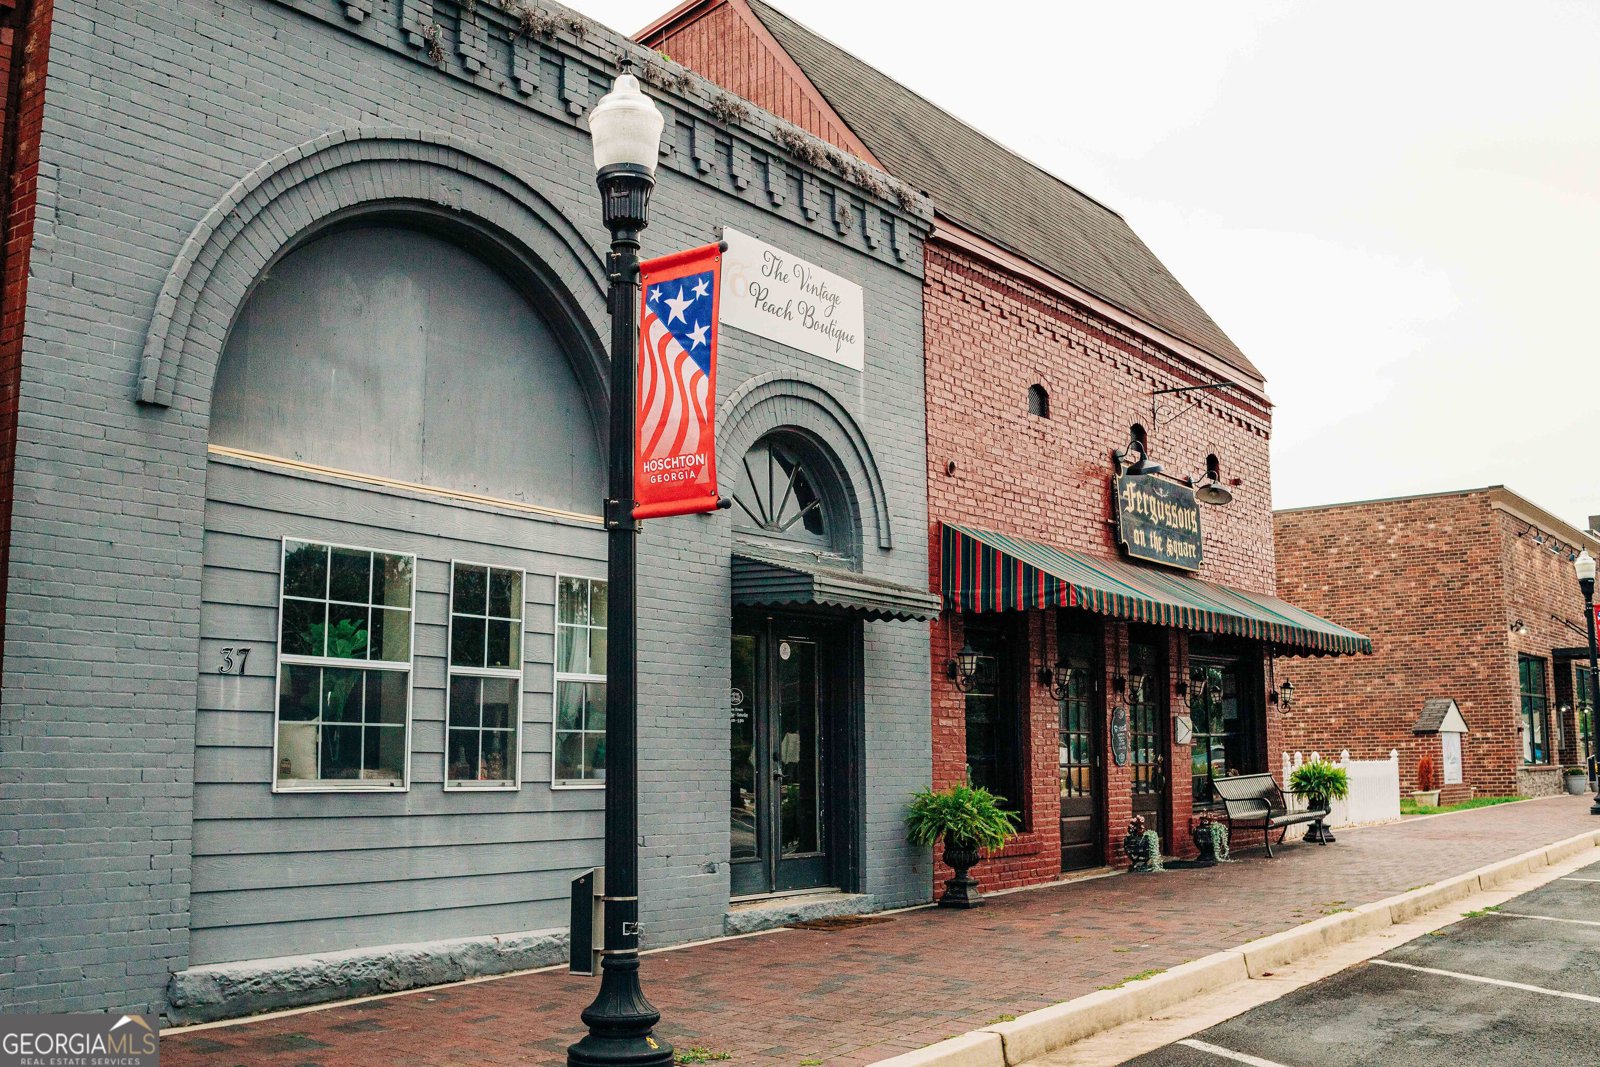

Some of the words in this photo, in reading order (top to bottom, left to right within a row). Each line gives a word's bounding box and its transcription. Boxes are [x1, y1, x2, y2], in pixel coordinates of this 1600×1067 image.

[761, 250, 790, 283] The
[793, 264, 841, 318] Vintage
[749, 281, 794, 321] Peach
[797, 300, 856, 354] Boutique
[643, 453, 705, 473] HOSCHTON
[650, 470, 696, 484] GEORGIA
[1133, 528, 1147, 548] on
[1149, 530, 1164, 553] the
[218, 646, 252, 675] 37
